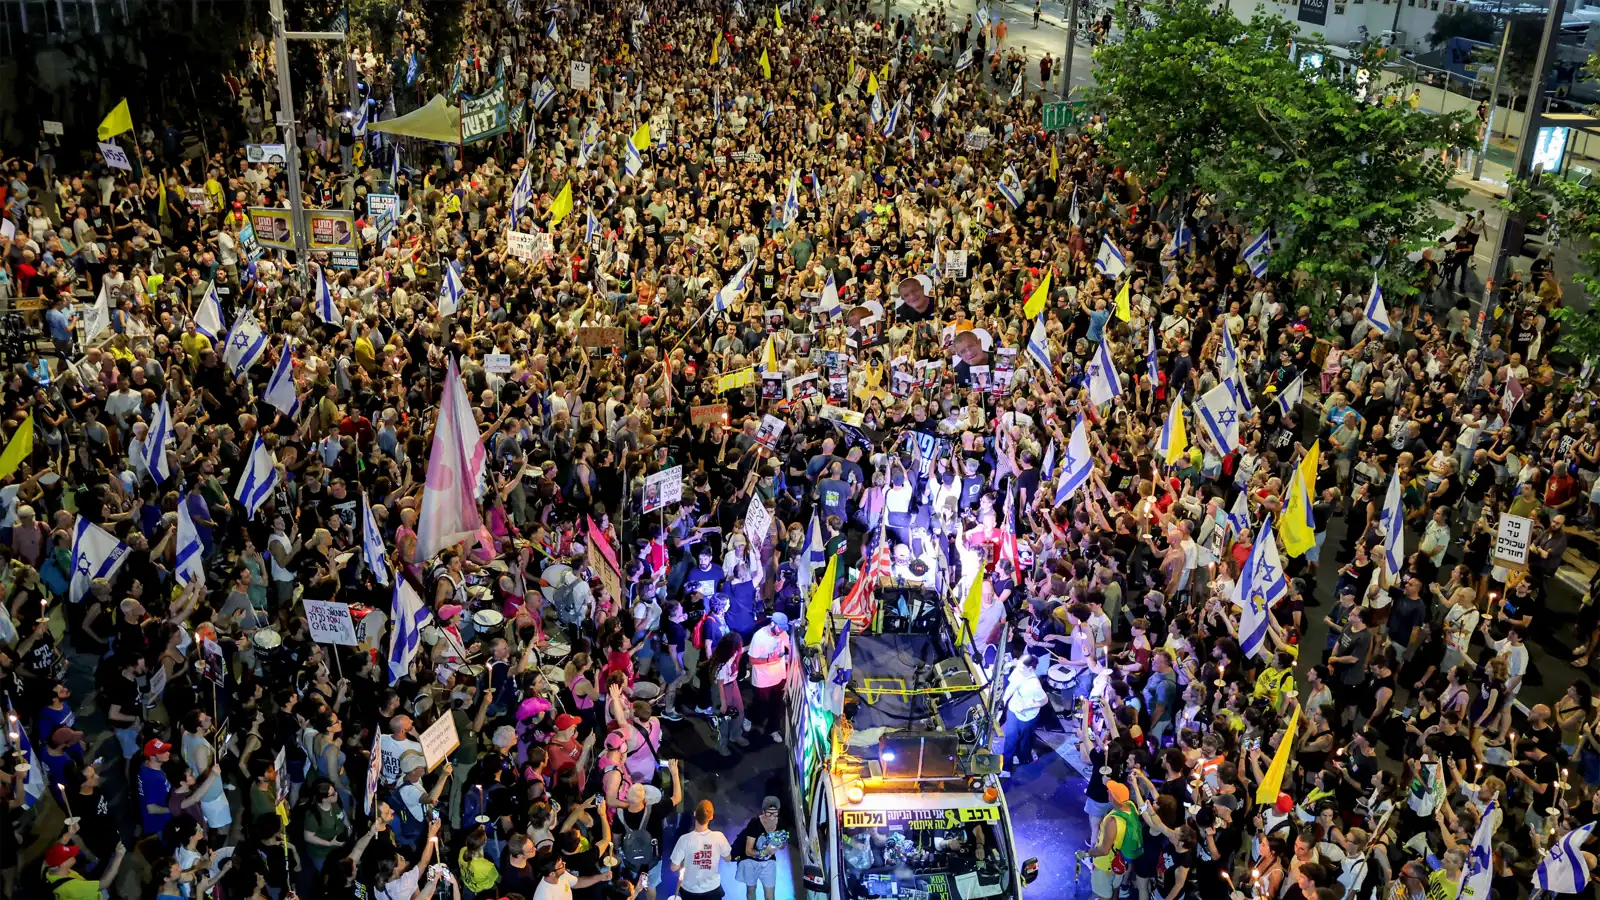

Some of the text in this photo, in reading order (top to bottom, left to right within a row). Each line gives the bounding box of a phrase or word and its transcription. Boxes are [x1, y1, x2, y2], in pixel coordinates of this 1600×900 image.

[461, 109, 496, 139] לנשק
[317, 219, 332, 229] מתן
[1508, 521, 1521, 529] פה
[1507, 530, 1520, 538] עד
[1498, 537, 1526, 549] שכולם
[1498, 547, 1523, 558] חוזרים
[846, 811, 884, 825] מלווה
[887, 809, 945, 821] אני בדרך הביתה
[967, 808, 991, 821] רכב
[693, 850, 712, 860] כולם
[927, 883, 948, 893] לעולם
